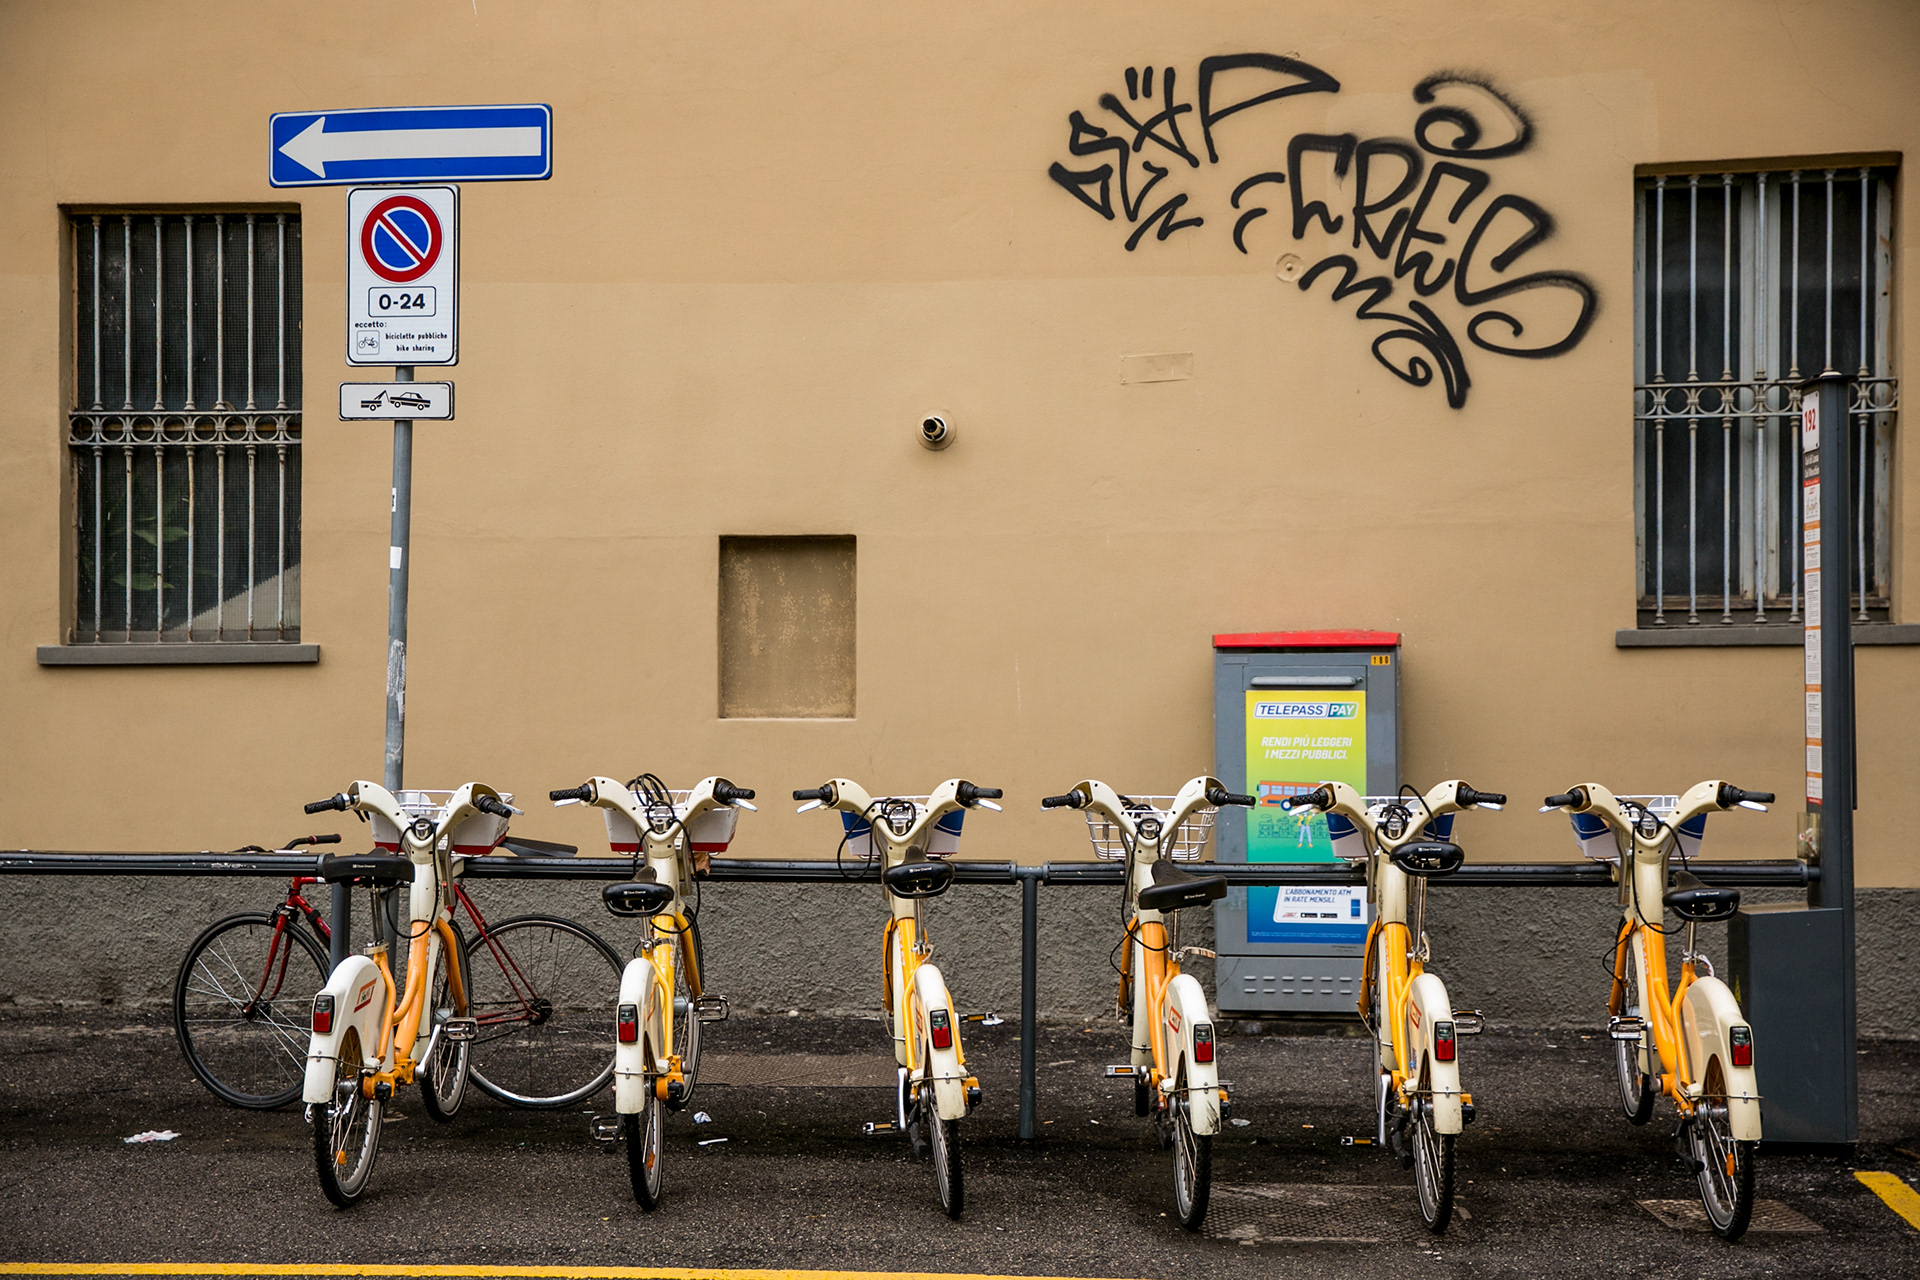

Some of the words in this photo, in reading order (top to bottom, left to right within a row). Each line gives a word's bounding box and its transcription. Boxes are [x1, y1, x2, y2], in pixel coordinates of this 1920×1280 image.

[378, 293, 426, 310] 0-24
[385, 332, 415, 340] biciclette
[418, 332, 448, 340] pubbliche
[396, 344, 409, 352] bike
[412, 344, 435, 353] sharing
[1804, 408, 1816, 432] 192
[1260, 705, 1323, 715] TELEPASS
[1330, 705, 1355, 716] PAY
[1261, 737, 1291, 747] RENDI
[1293, 734, 1310, 747] PIÙ
[1311, 737, 1352, 747] LEGGERI
[1265, 749, 1270, 759] I
[1270, 749, 1301, 759] MEZZI
[1301, 749, 1348, 760] PUBBLICI.
